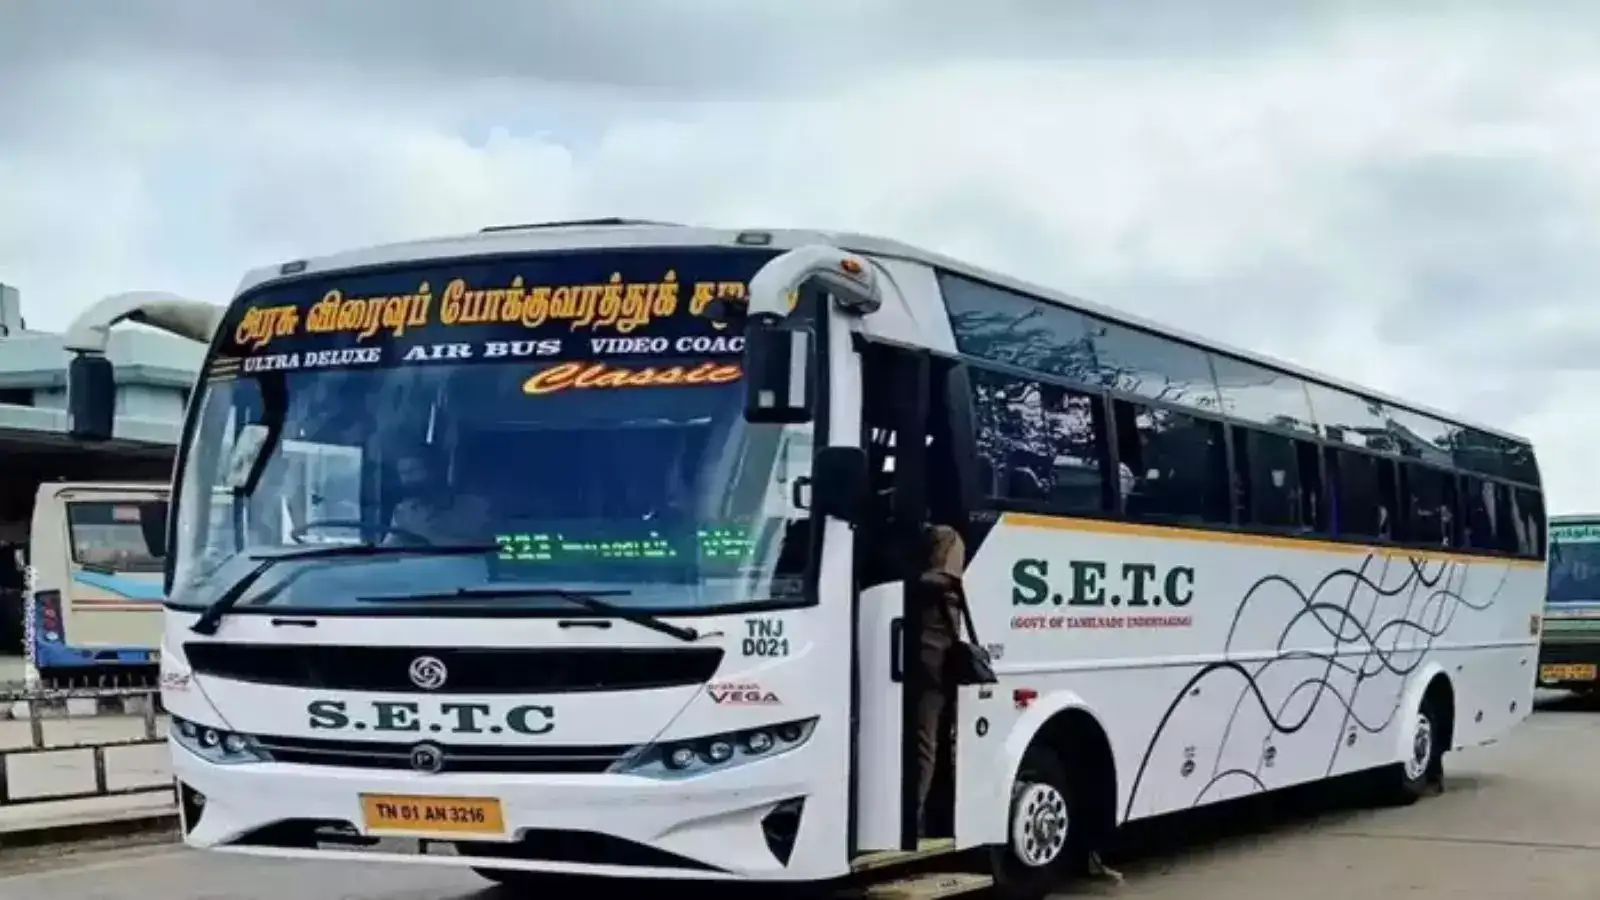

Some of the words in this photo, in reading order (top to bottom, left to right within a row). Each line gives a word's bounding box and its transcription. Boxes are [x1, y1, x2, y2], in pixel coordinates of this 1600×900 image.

[235, 304, 299, 350] அரசு
[305, 280, 433, 343] விரைவுப்
[440, 270, 679, 333] போக்குவரத்துக்
[243, 351, 299, 373] ULTRA
[303, 347, 381, 369] DELUXE
[403, 342, 472, 361] AIR
[483, 339, 562, 358] BUS
[590, 336, 669, 355] VIDEO
[675, 335, 746, 352] COAC
[522, 361, 743, 394] Classic
[1011, 558, 1195, 607] S.E.T.C
[744, 618, 783, 637] TNJ
[1049, 615, 1063, 629] OF
[1067, 615, 1124, 629] TAMILNADU
[742, 638, 789, 657] D021
[708, 691, 783, 705] VEGA
[307, 700, 555, 734] S.E.T.C
[375, 802, 397, 819] TN
[401, 804, 419, 821] 01
[425, 805, 447, 821] AN
[449, 806, 485, 824] 3216
